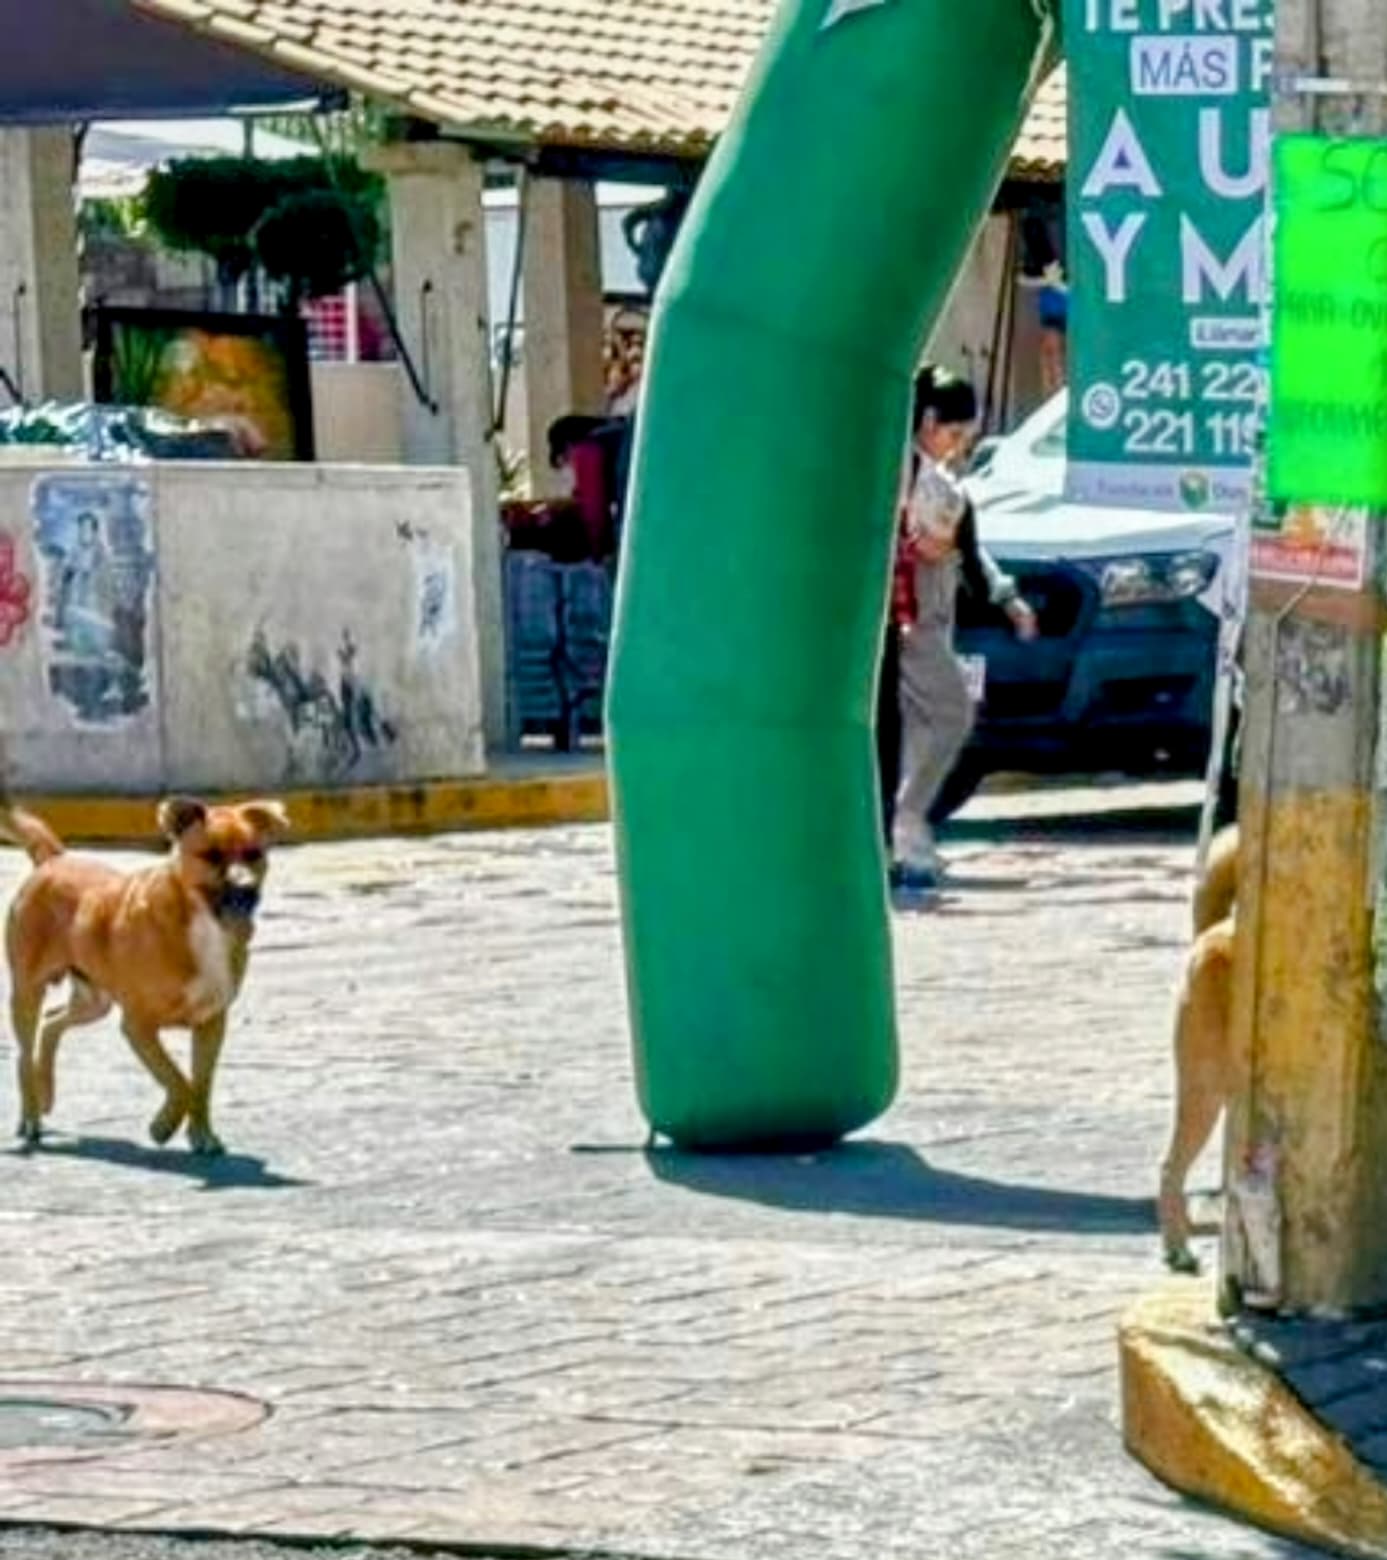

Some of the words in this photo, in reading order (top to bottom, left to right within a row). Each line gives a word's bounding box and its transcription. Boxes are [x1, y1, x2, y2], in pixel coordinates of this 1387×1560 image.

[1140, 41, 1228, 89] MÁS
[1120, 360, 1191, 400] 241
[1123, 409, 1195, 453] 221
